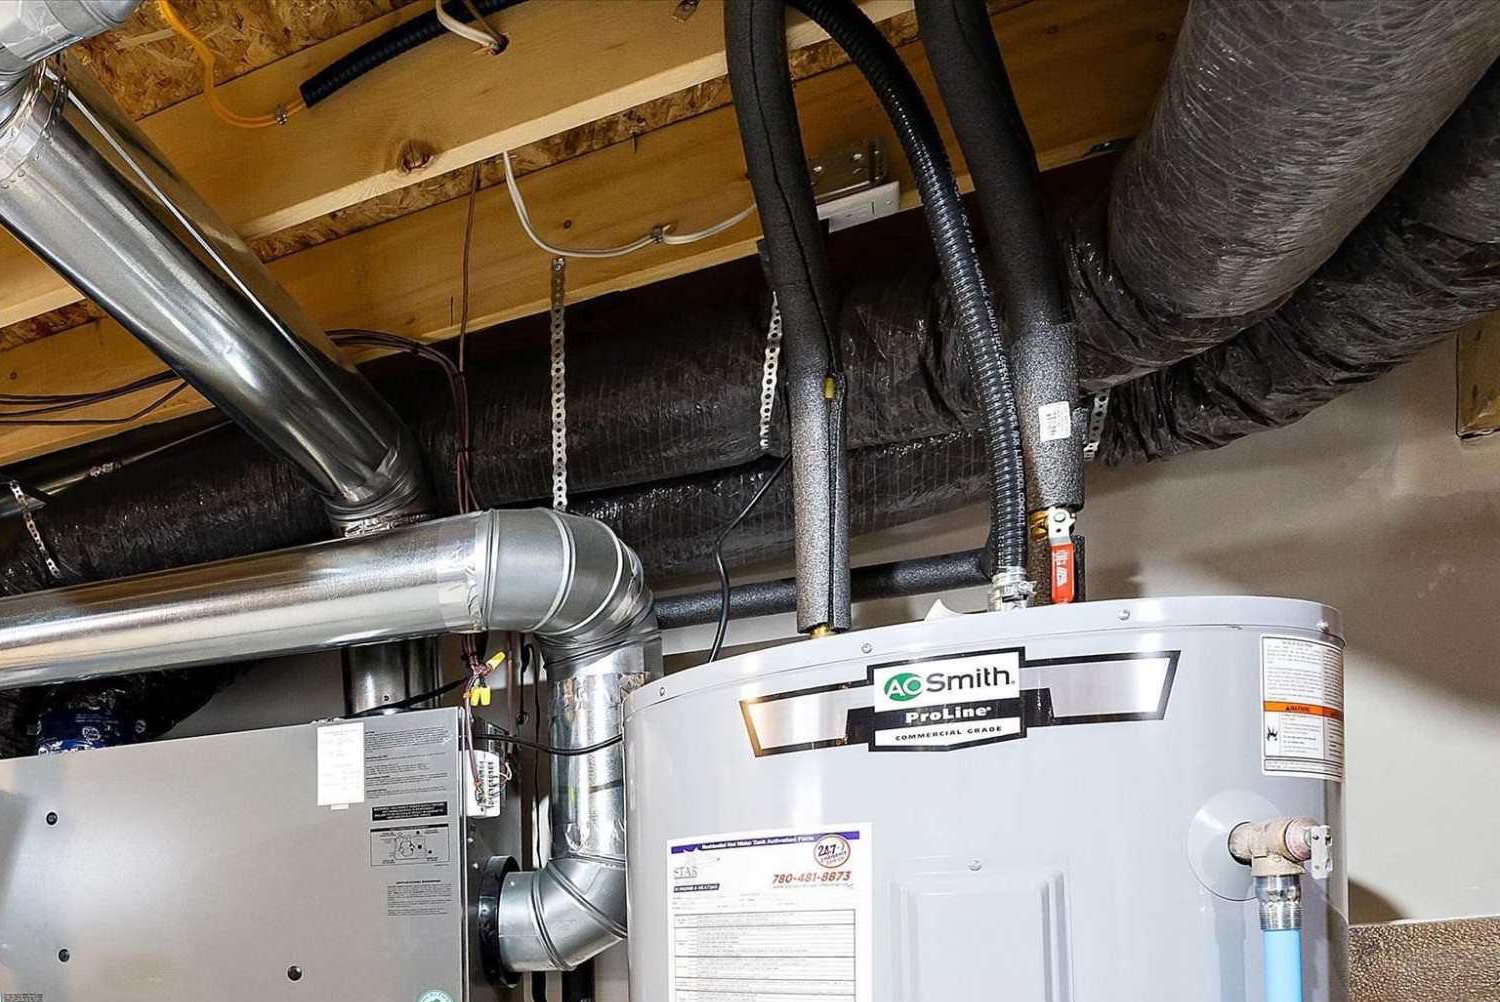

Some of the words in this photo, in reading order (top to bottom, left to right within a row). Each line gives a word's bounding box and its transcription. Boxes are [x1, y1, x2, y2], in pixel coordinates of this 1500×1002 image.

[926, 667, 1011, 694] Smith
[895, 728, 963, 742] COMMERCIAL
[967, 725, 1003, 736] GRADE
[766, 834, 797, 844] Activation
[772, 871, 852, 884] 780-481-8873
